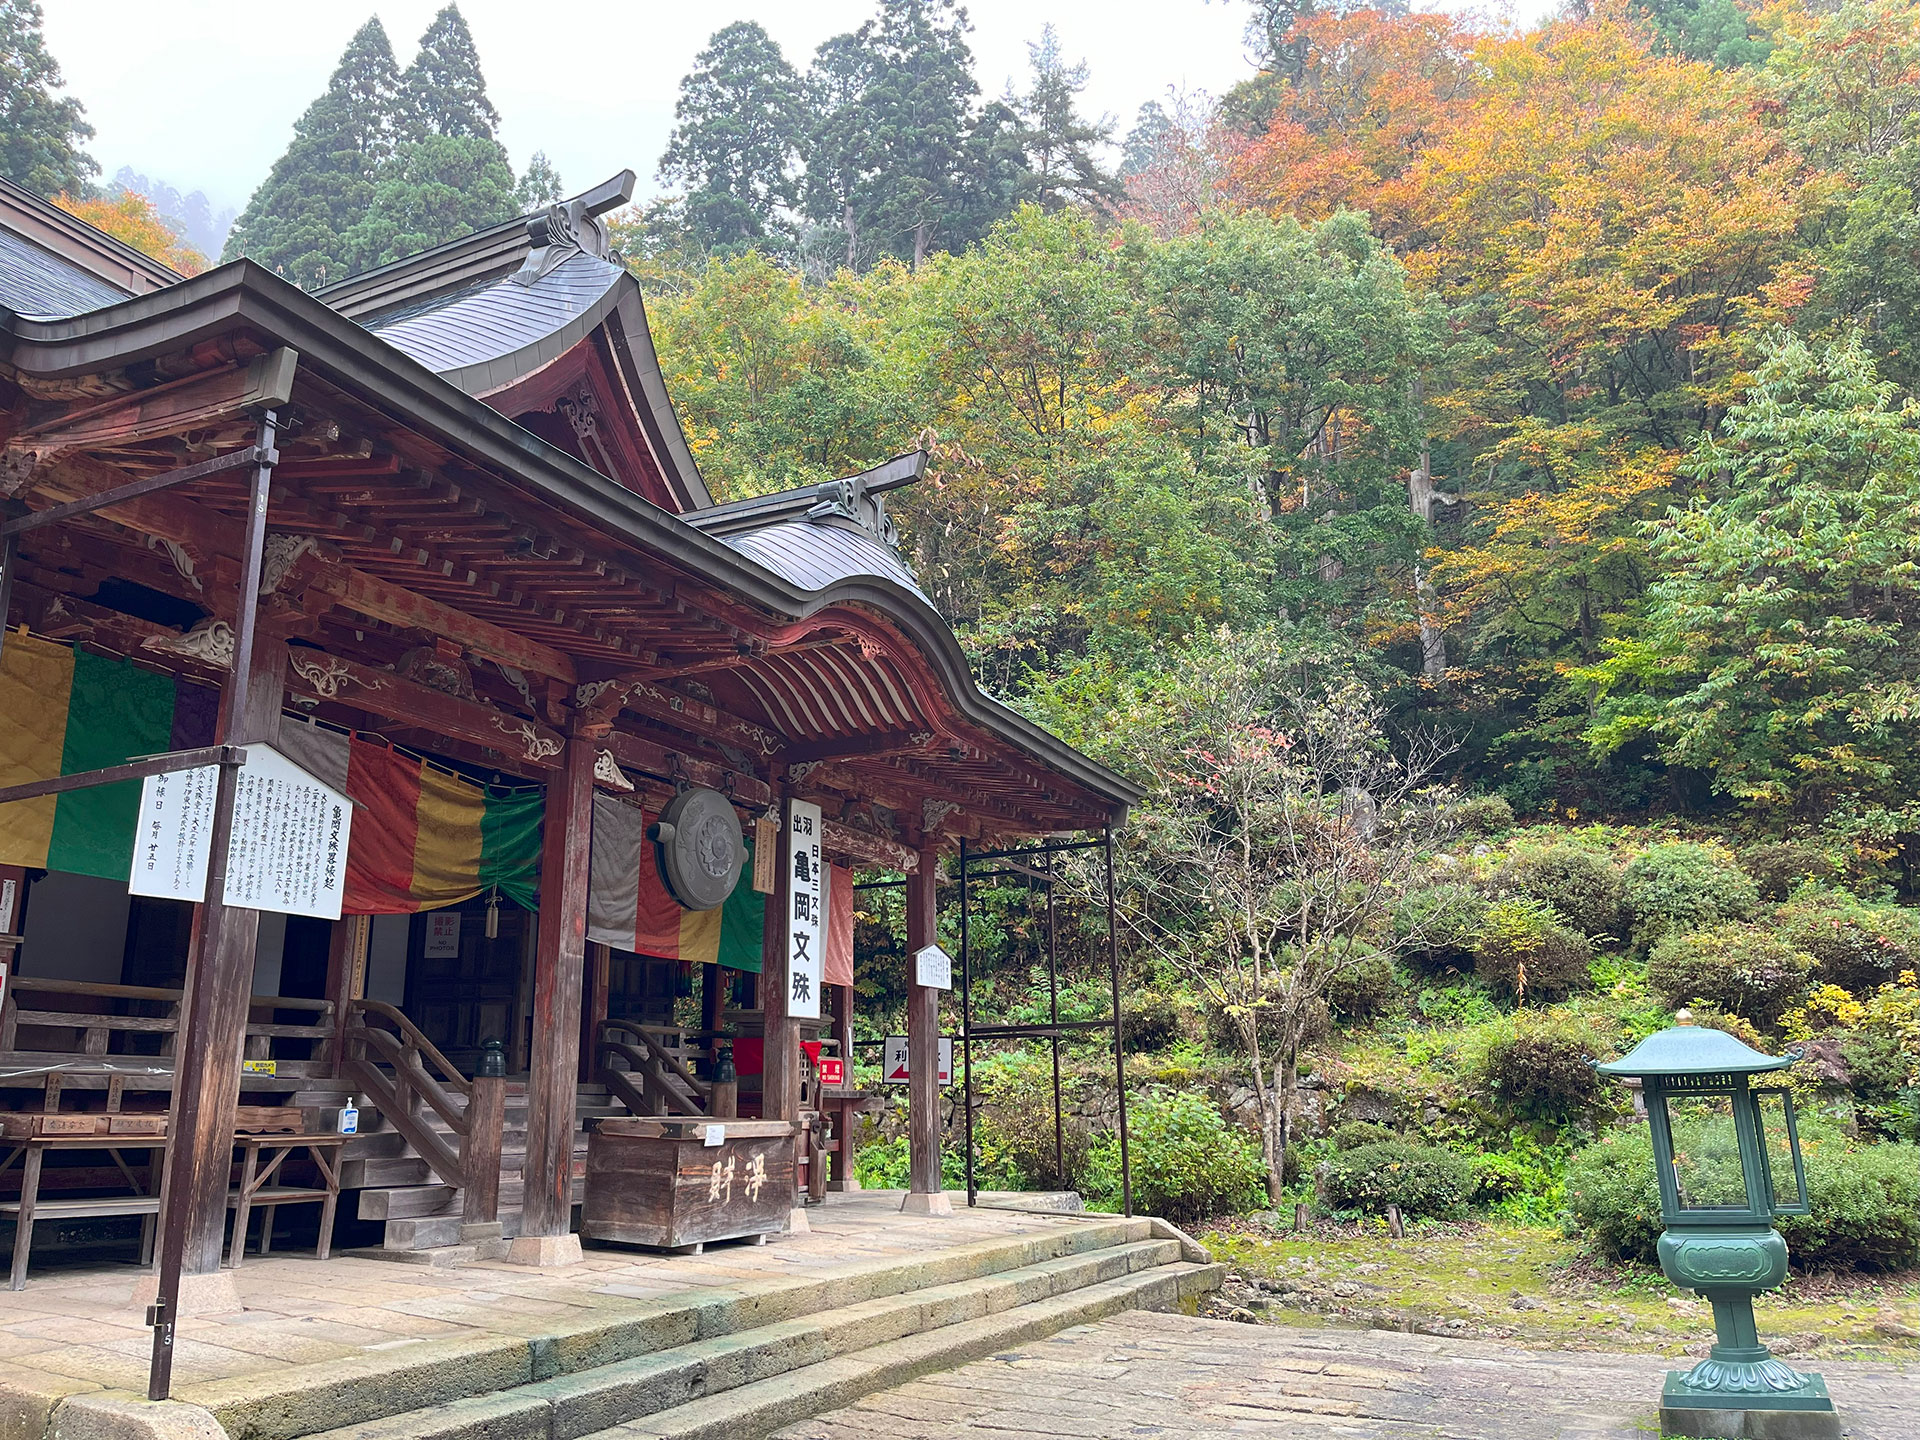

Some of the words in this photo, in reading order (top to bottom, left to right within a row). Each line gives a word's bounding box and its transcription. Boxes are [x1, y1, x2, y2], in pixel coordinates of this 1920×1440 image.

[792, 814, 813, 836] 出羽
[792, 850, 811, 1004] 亀岡文殊
[810, 844, 820, 928] 日本三文殊
